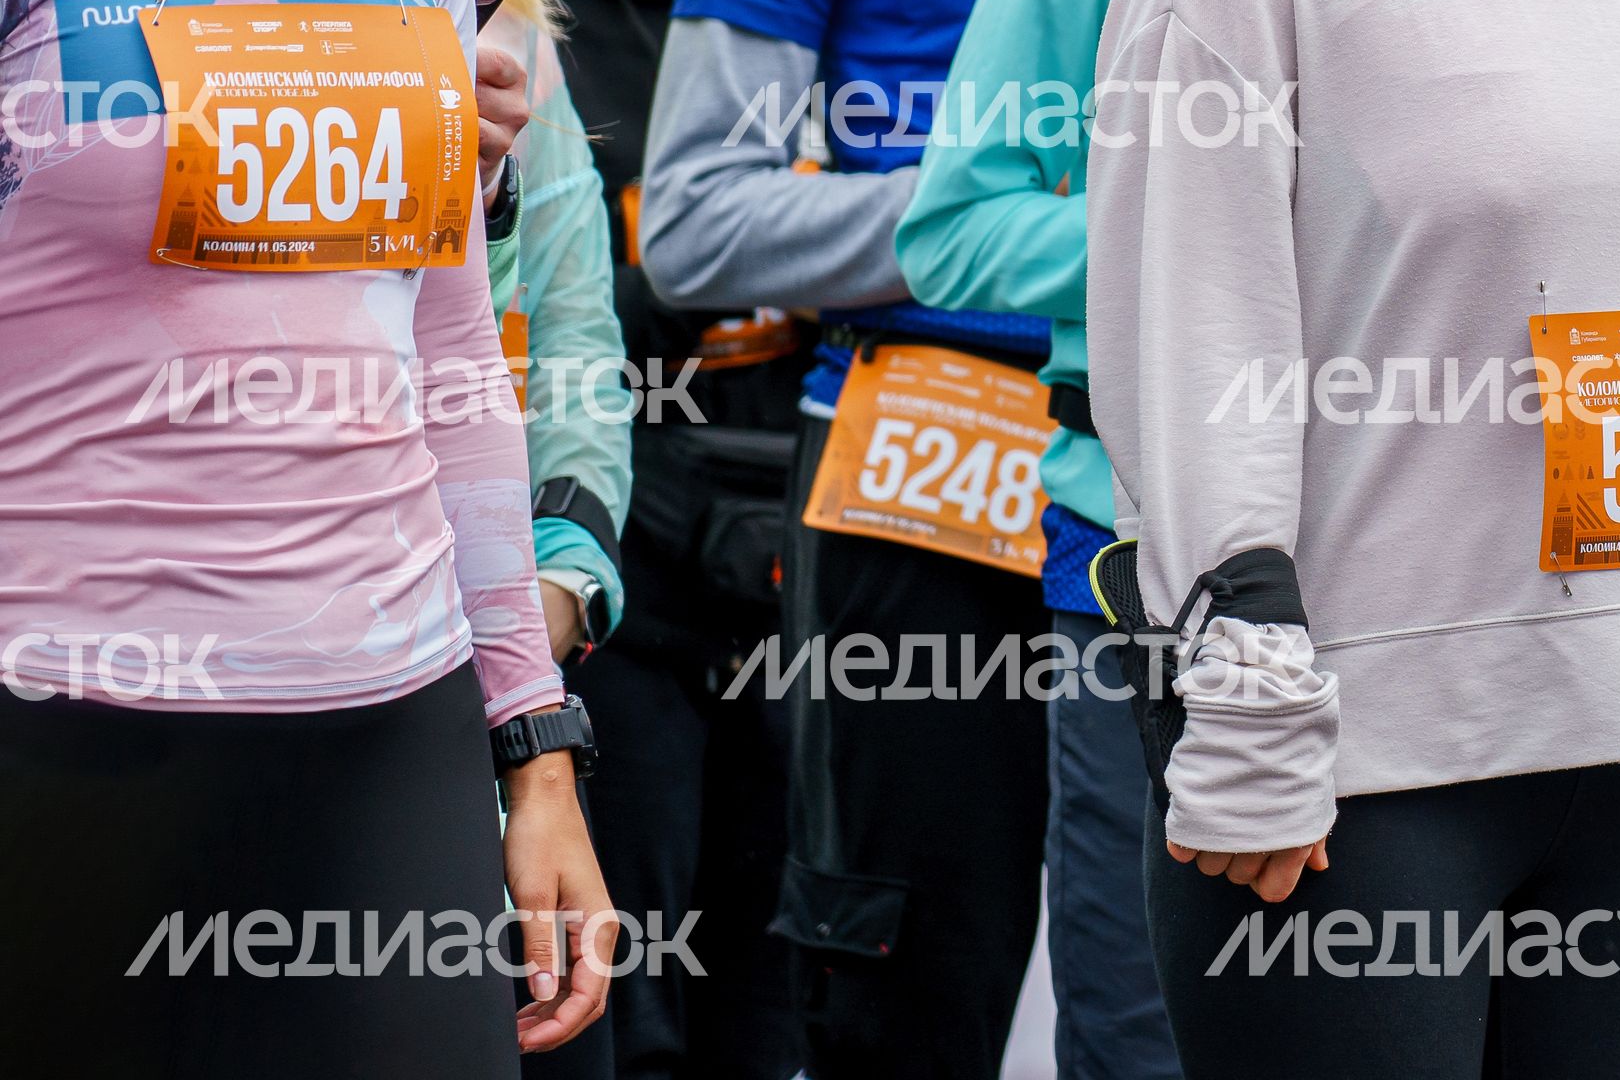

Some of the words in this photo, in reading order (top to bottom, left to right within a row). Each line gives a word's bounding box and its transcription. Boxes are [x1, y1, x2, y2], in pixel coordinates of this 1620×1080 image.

[204, 70, 314, 87] КОЛОМЕНСКИЙ
[316, 71, 425, 89] ПОЛУМАРАФОН
[216, 106, 408, 223] 5264
[203, 241, 256, 252] КОЛОМНА
[368, 235, 381, 253] 5
[859, 418, 1042, 534] 5248
